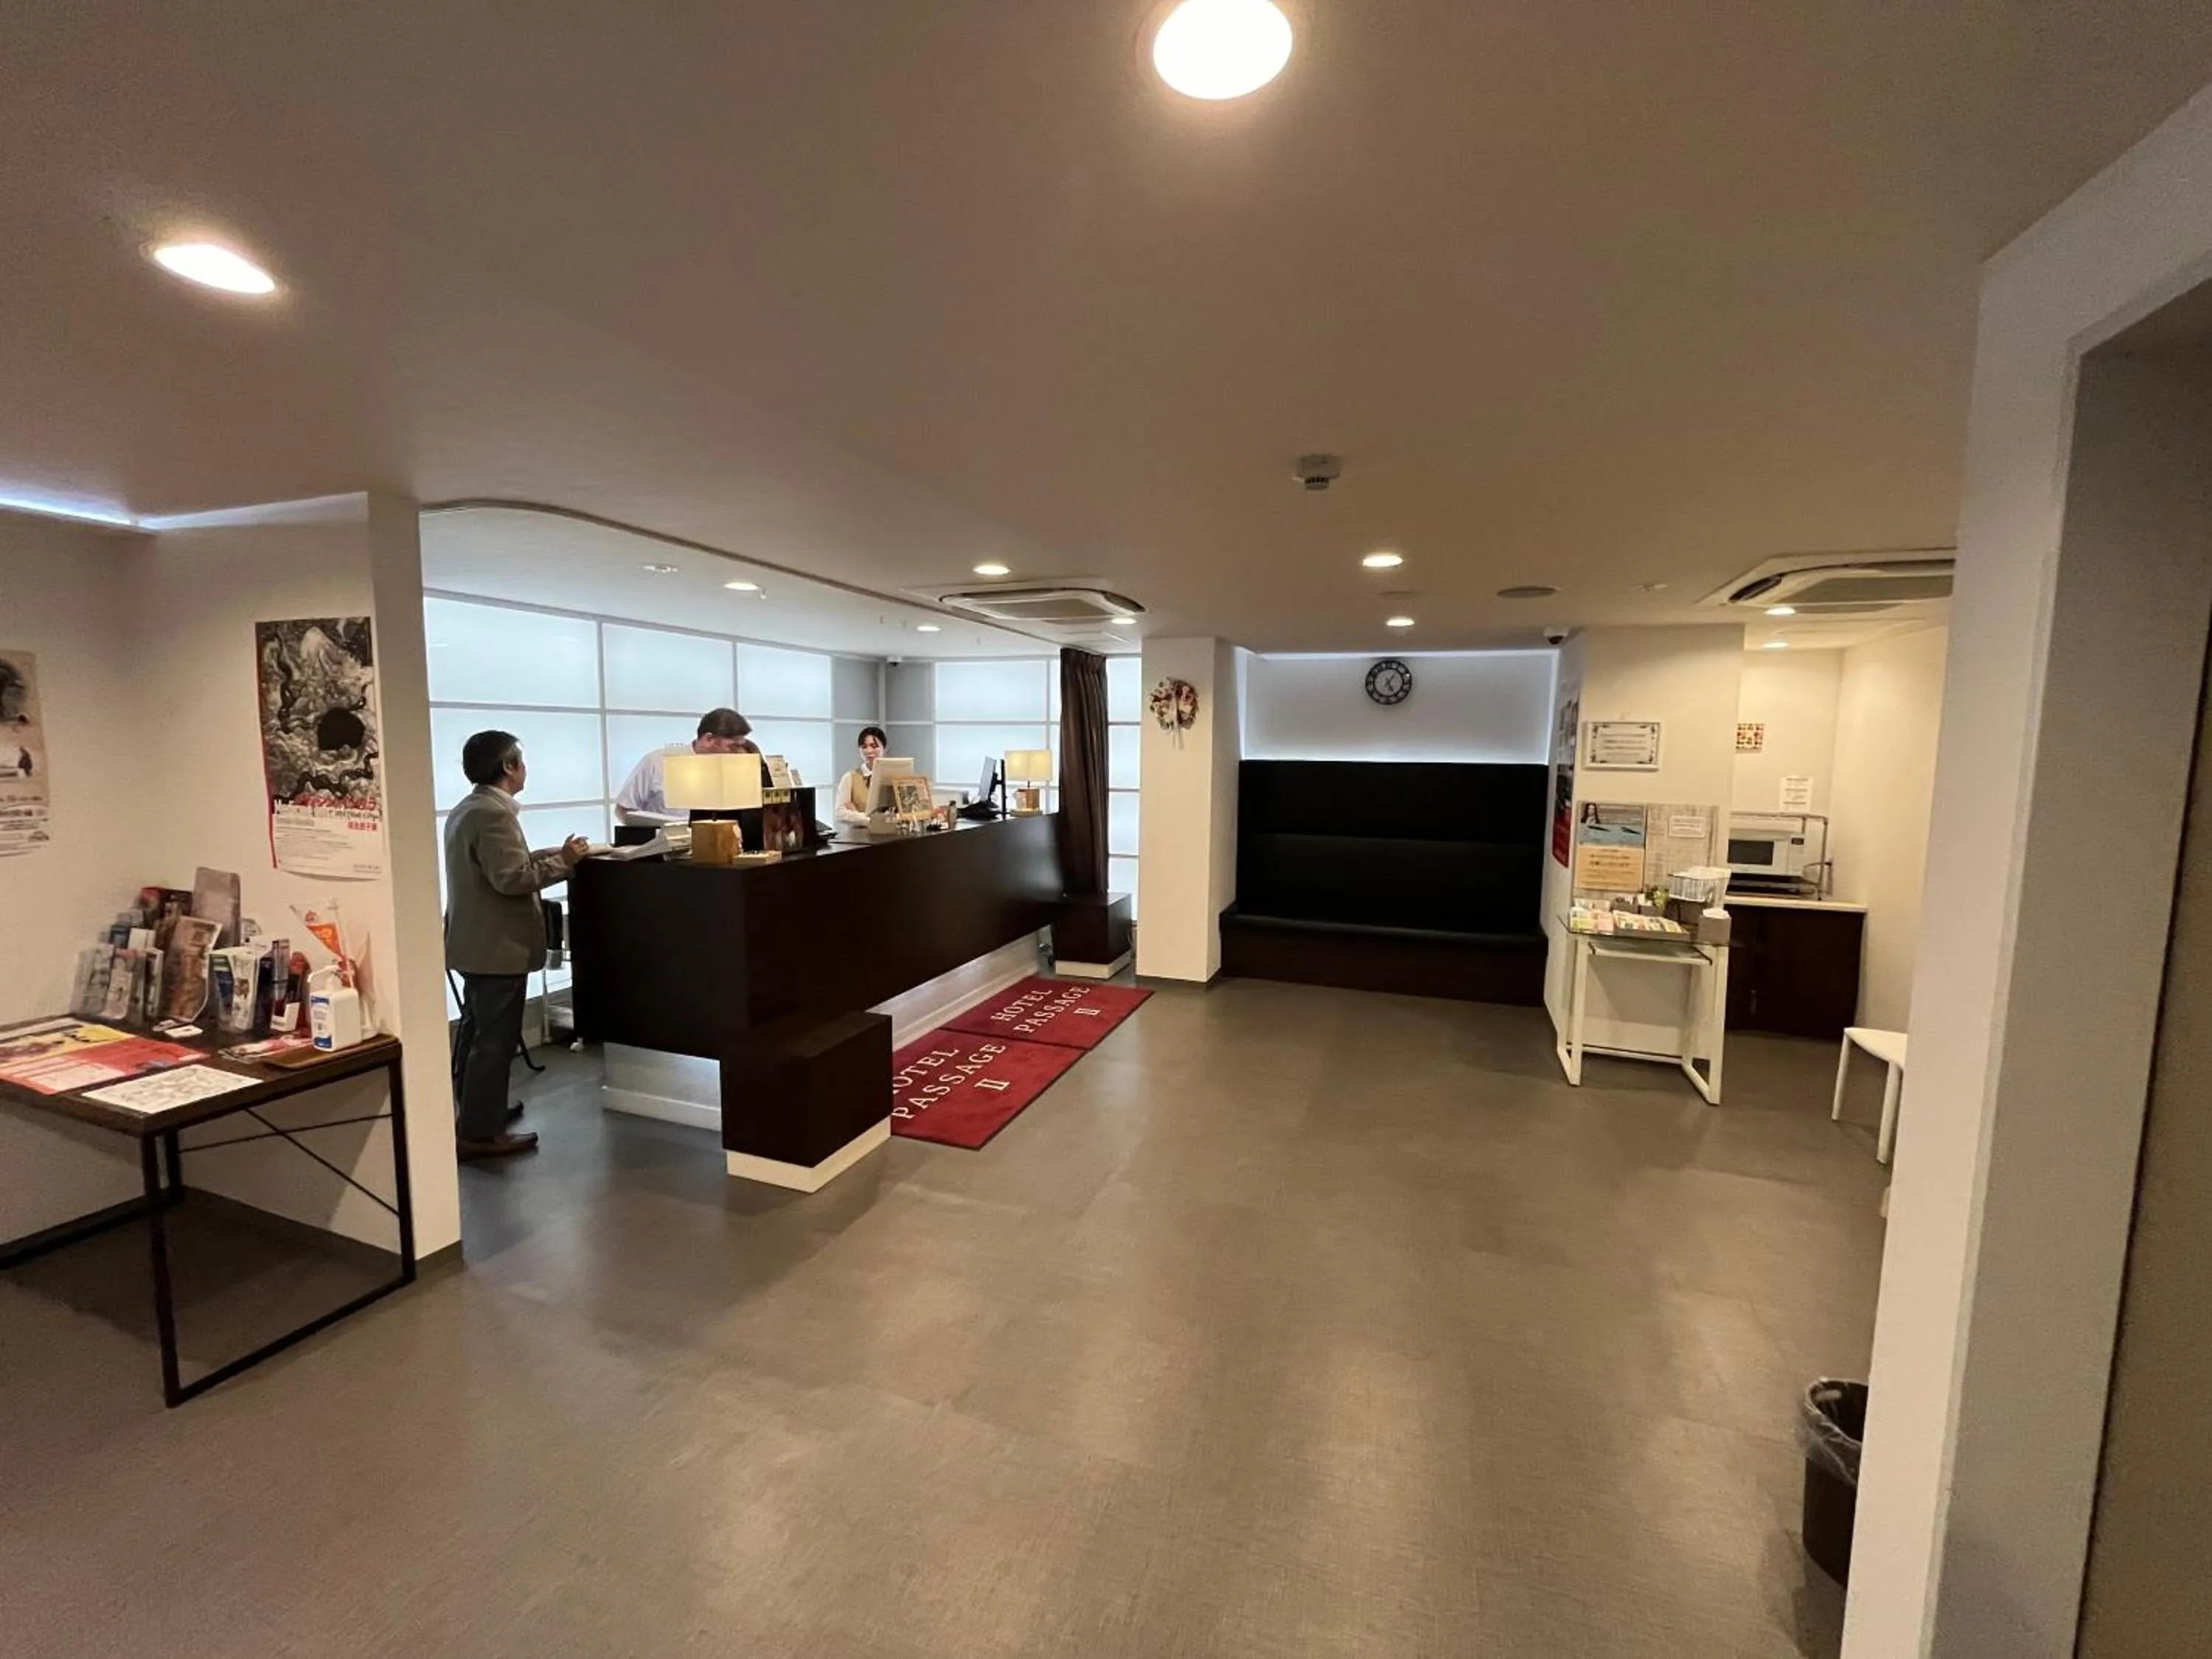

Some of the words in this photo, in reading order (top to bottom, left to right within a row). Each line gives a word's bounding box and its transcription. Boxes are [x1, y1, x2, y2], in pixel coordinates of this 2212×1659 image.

[991, 990, 1052, 1020] HOTEL
[1012, 987, 1091, 1033] PASSAGE
[891, 1044, 1006, 1119] PASSAGE
[893, 1049, 960, 1094] OTEL
